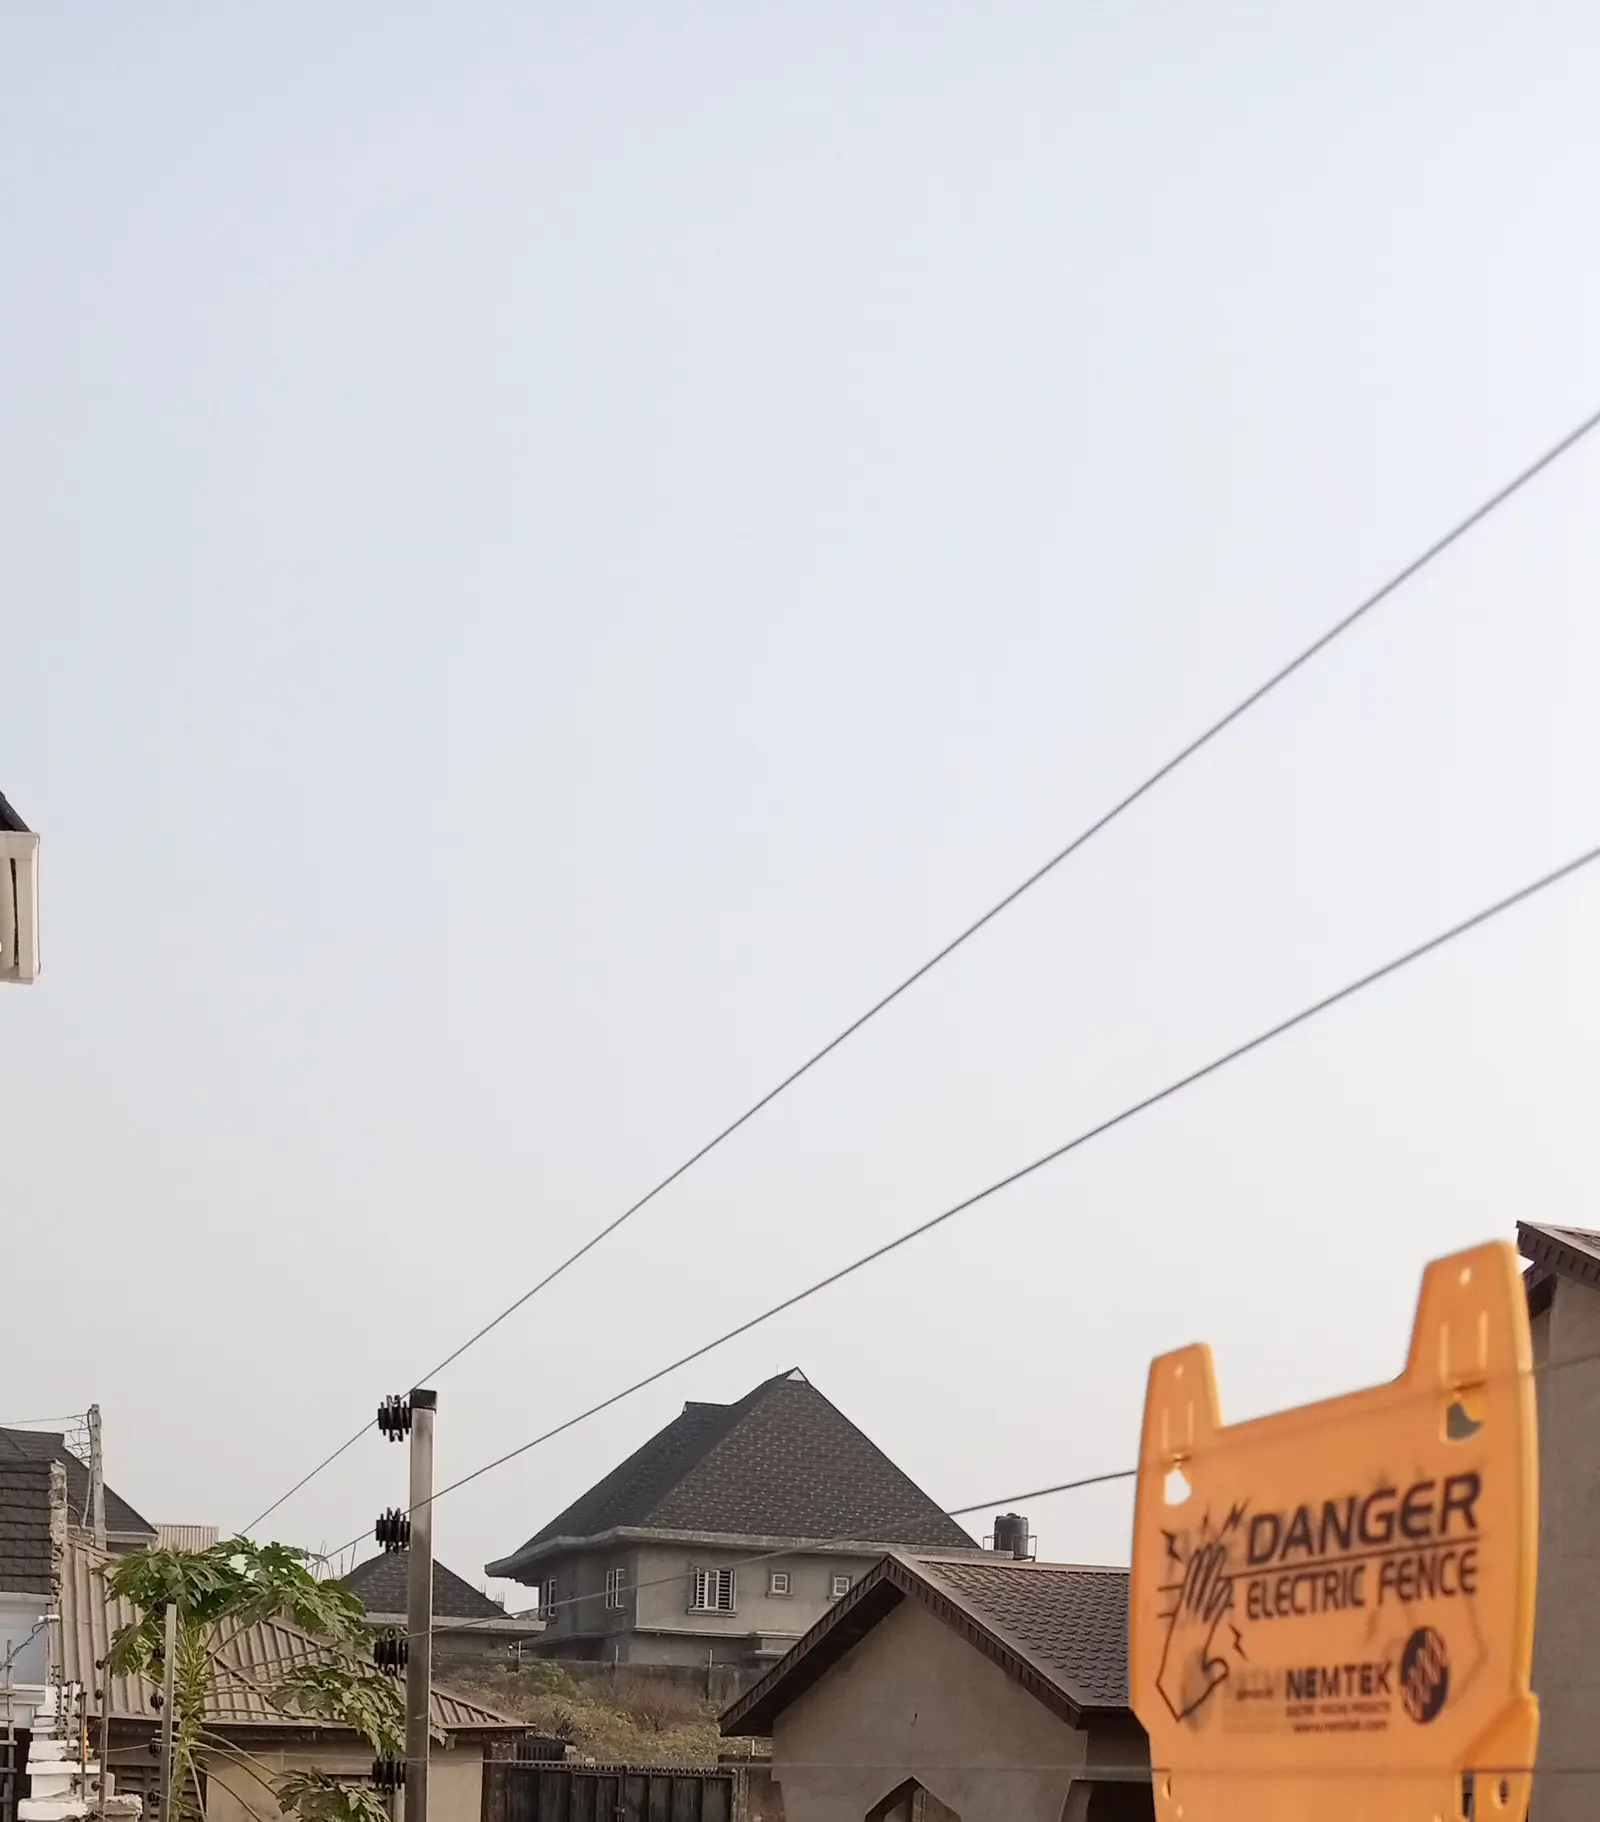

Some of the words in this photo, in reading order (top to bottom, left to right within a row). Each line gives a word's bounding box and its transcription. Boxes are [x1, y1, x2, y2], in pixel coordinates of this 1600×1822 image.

[1247, 1473, 1480, 1565] DANGER
[1246, 1565, 1365, 1621] ELECTRIC
[1377, 1550, 1477, 1605] FENCE
[1285, 1664, 1392, 1700] NEMTEK
